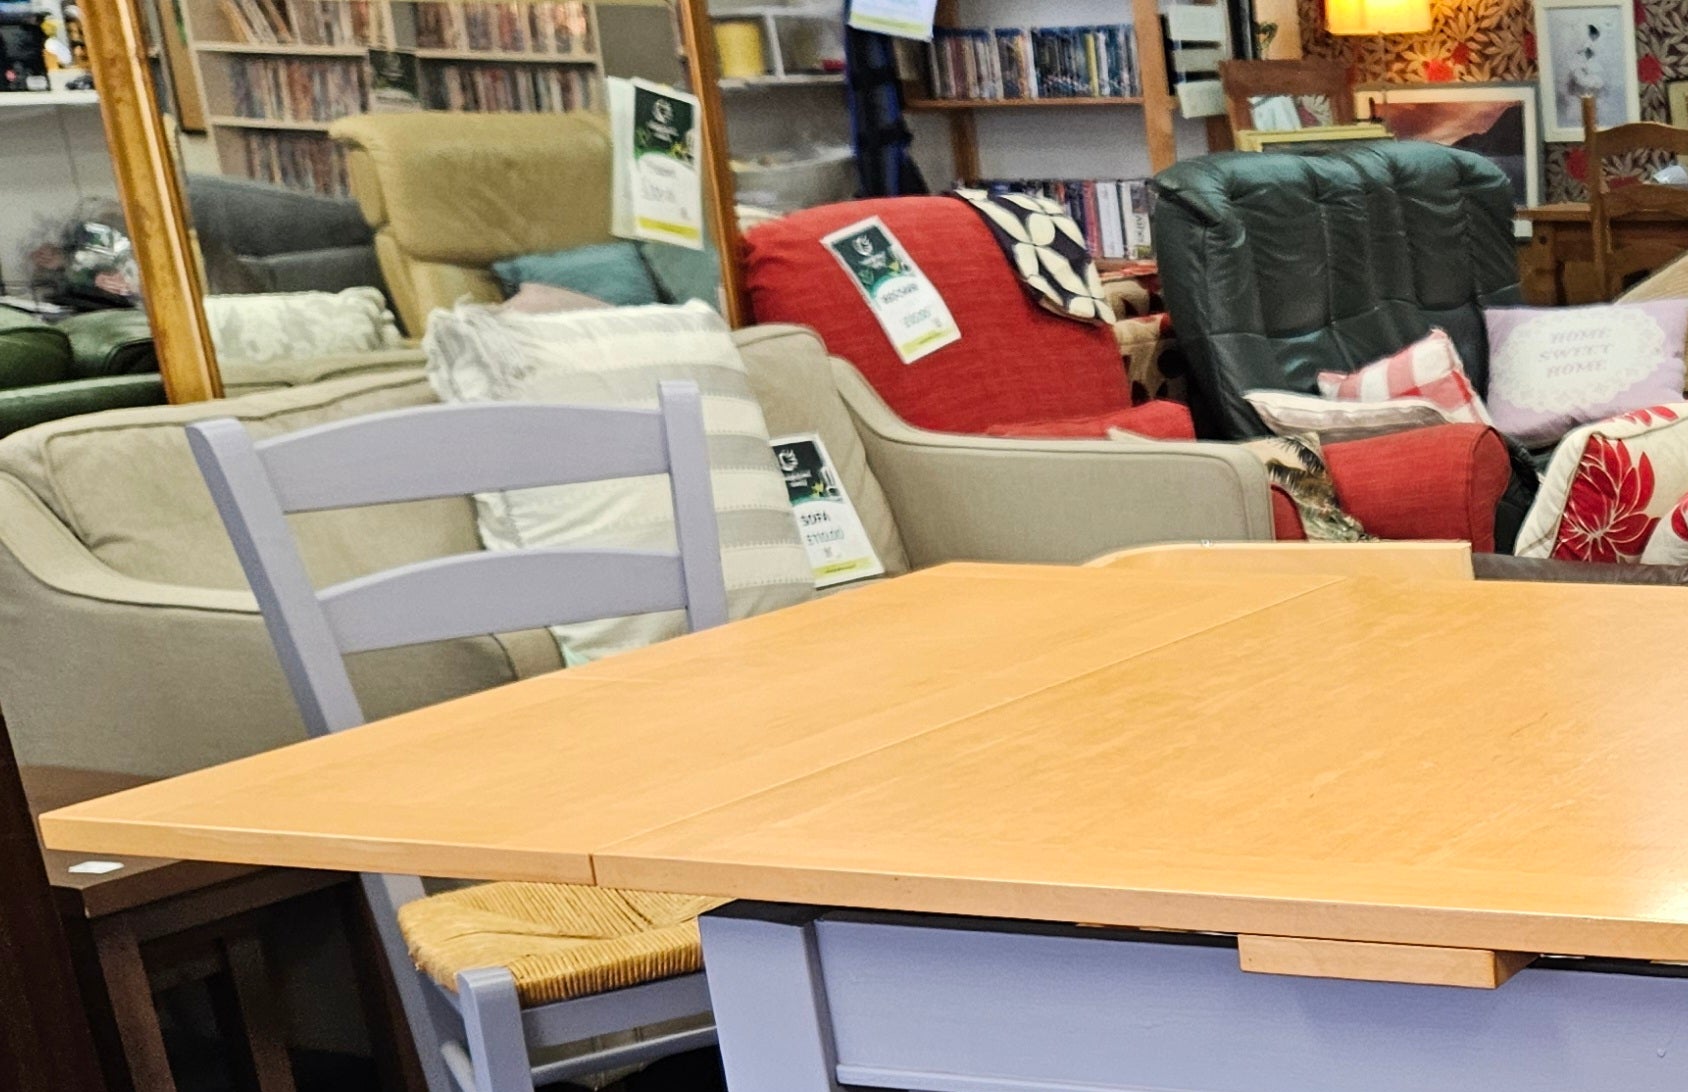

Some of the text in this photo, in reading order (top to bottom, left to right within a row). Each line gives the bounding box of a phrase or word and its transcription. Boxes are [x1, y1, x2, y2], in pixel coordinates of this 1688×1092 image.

[1551, 328, 1608, 344] HOME
[1539, 344, 1611, 360] SWEET
[1547, 361, 1605, 377] HOME
